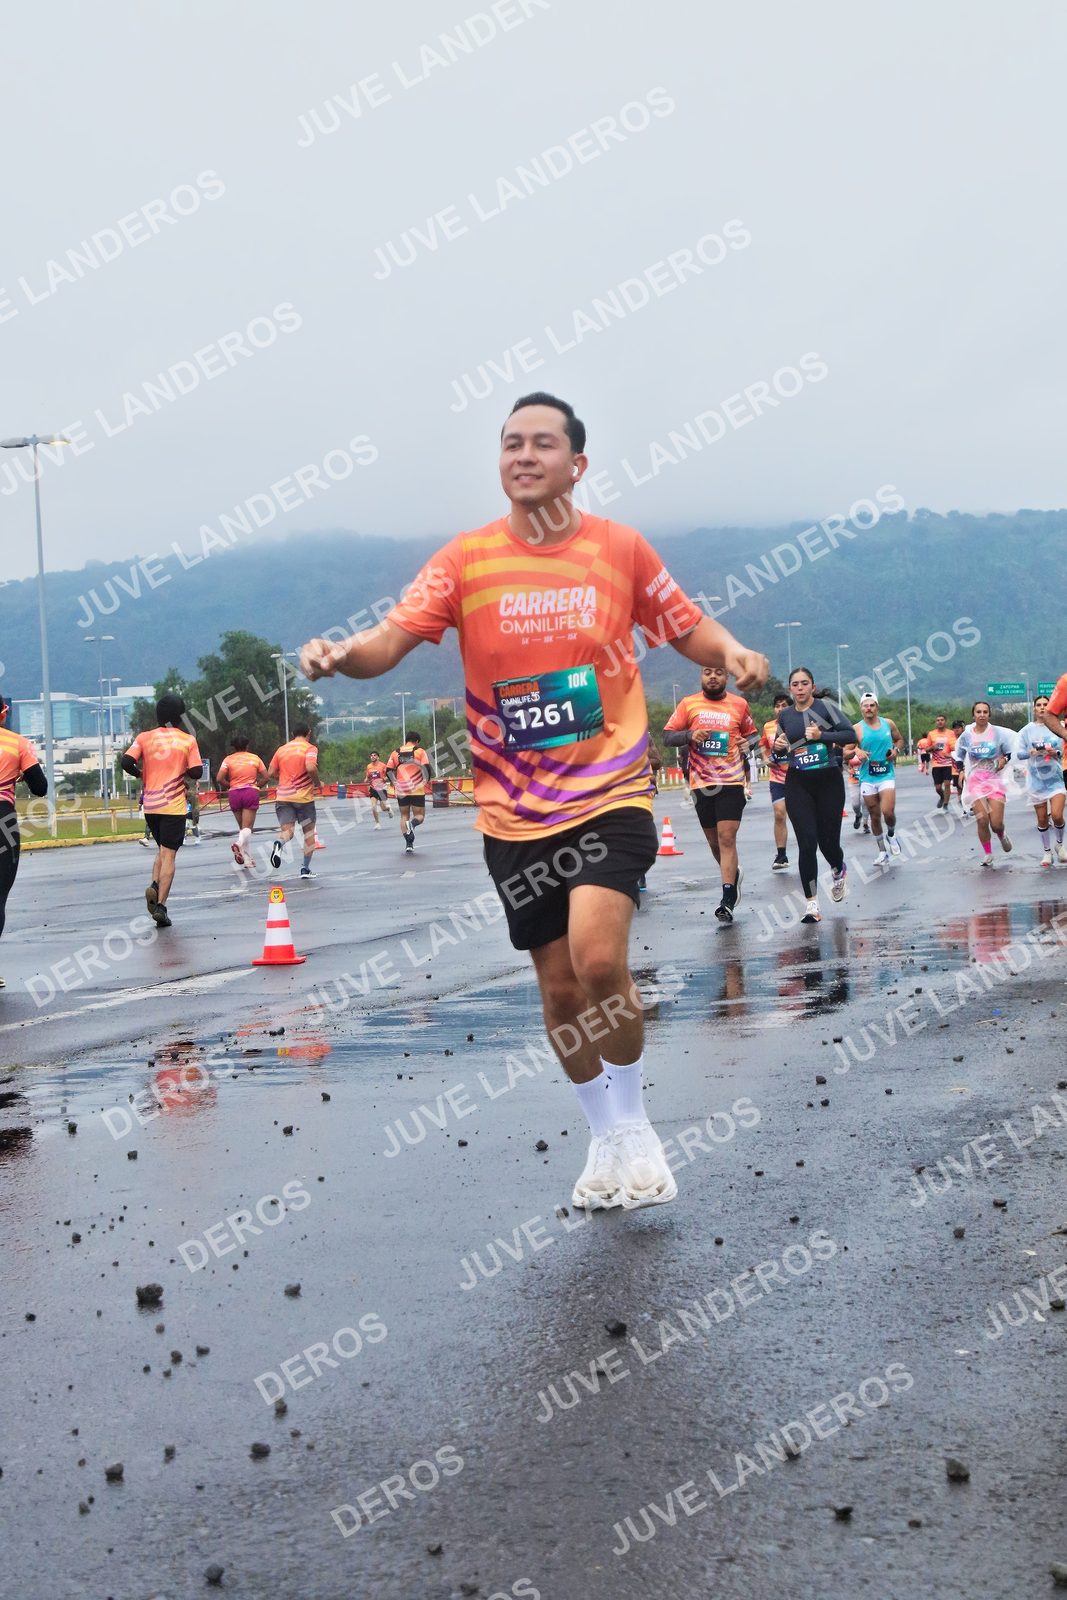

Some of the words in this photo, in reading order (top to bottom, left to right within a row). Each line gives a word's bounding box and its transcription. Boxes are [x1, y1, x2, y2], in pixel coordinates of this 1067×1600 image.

[499, 586, 596, 616] CARRERA
[500, 614, 576, 634] OMNILIFE
[568, 671, 588, 689] 10K
[500, 681, 539, 698] CARRERA
[514, 701, 575, 730] 1261
[702, 741, 721, 749] 1623
[799, 753, 819, 765] 1622
